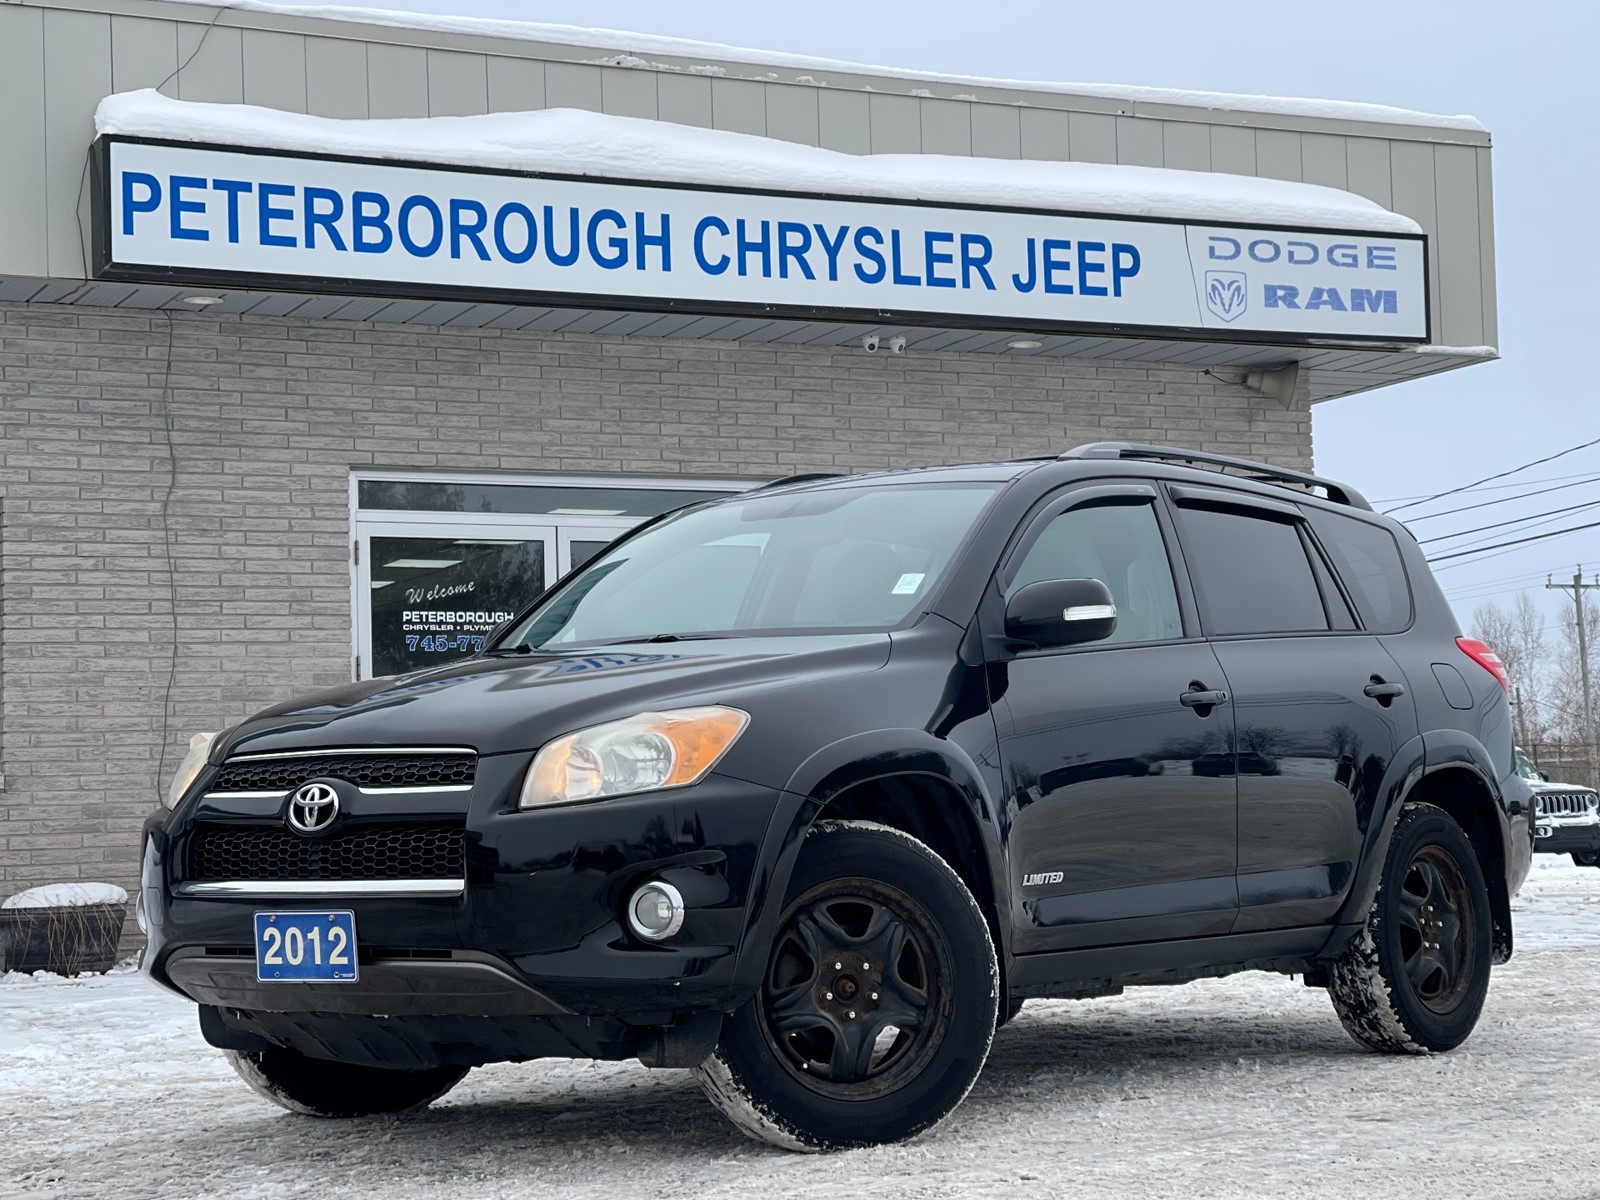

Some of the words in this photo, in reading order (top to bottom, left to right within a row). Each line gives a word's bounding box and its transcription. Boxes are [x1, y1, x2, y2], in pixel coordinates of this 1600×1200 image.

[121, 170, 672, 273] PETERBOROUGH
[693, 215, 997, 291] CHRYSLER
[1011, 237, 1141, 298] JEEP
[1207, 235, 1398, 271] DODGE
[1262, 283, 1399, 314] RAM
[405, 580, 476, 605] Welcome
[402, 610, 515, 623] PETERBOROUGH
[1022, 871, 1064, 887] LIMITED
[262, 926, 349, 966] 2012
